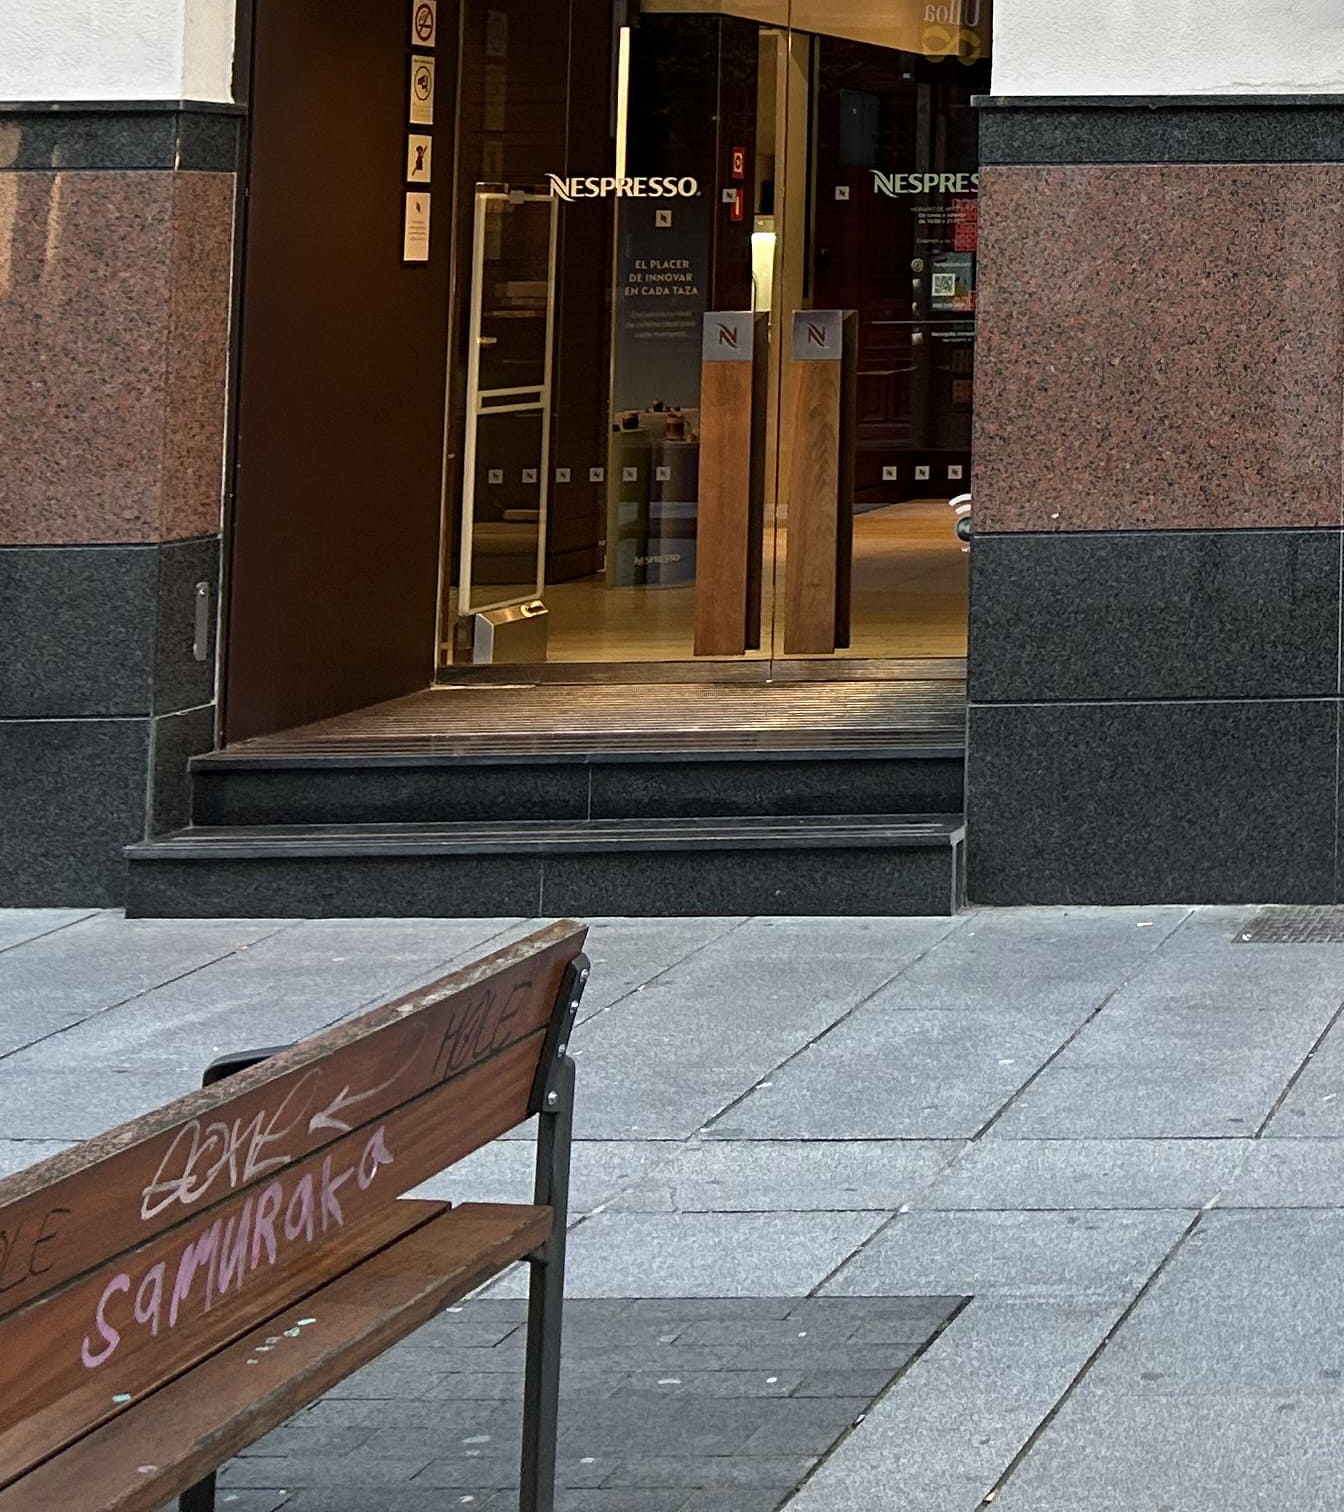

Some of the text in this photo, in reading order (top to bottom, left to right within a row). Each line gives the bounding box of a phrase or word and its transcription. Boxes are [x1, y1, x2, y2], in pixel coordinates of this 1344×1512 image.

[544, 172, 699, 203] NESPRESSO
[635, 259, 689, 270] EL PLACER
[628, 272, 693, 283] DE INNOVAR
[624, 285, 640, 296] EN
[641, 285, 670, 296] CADA
